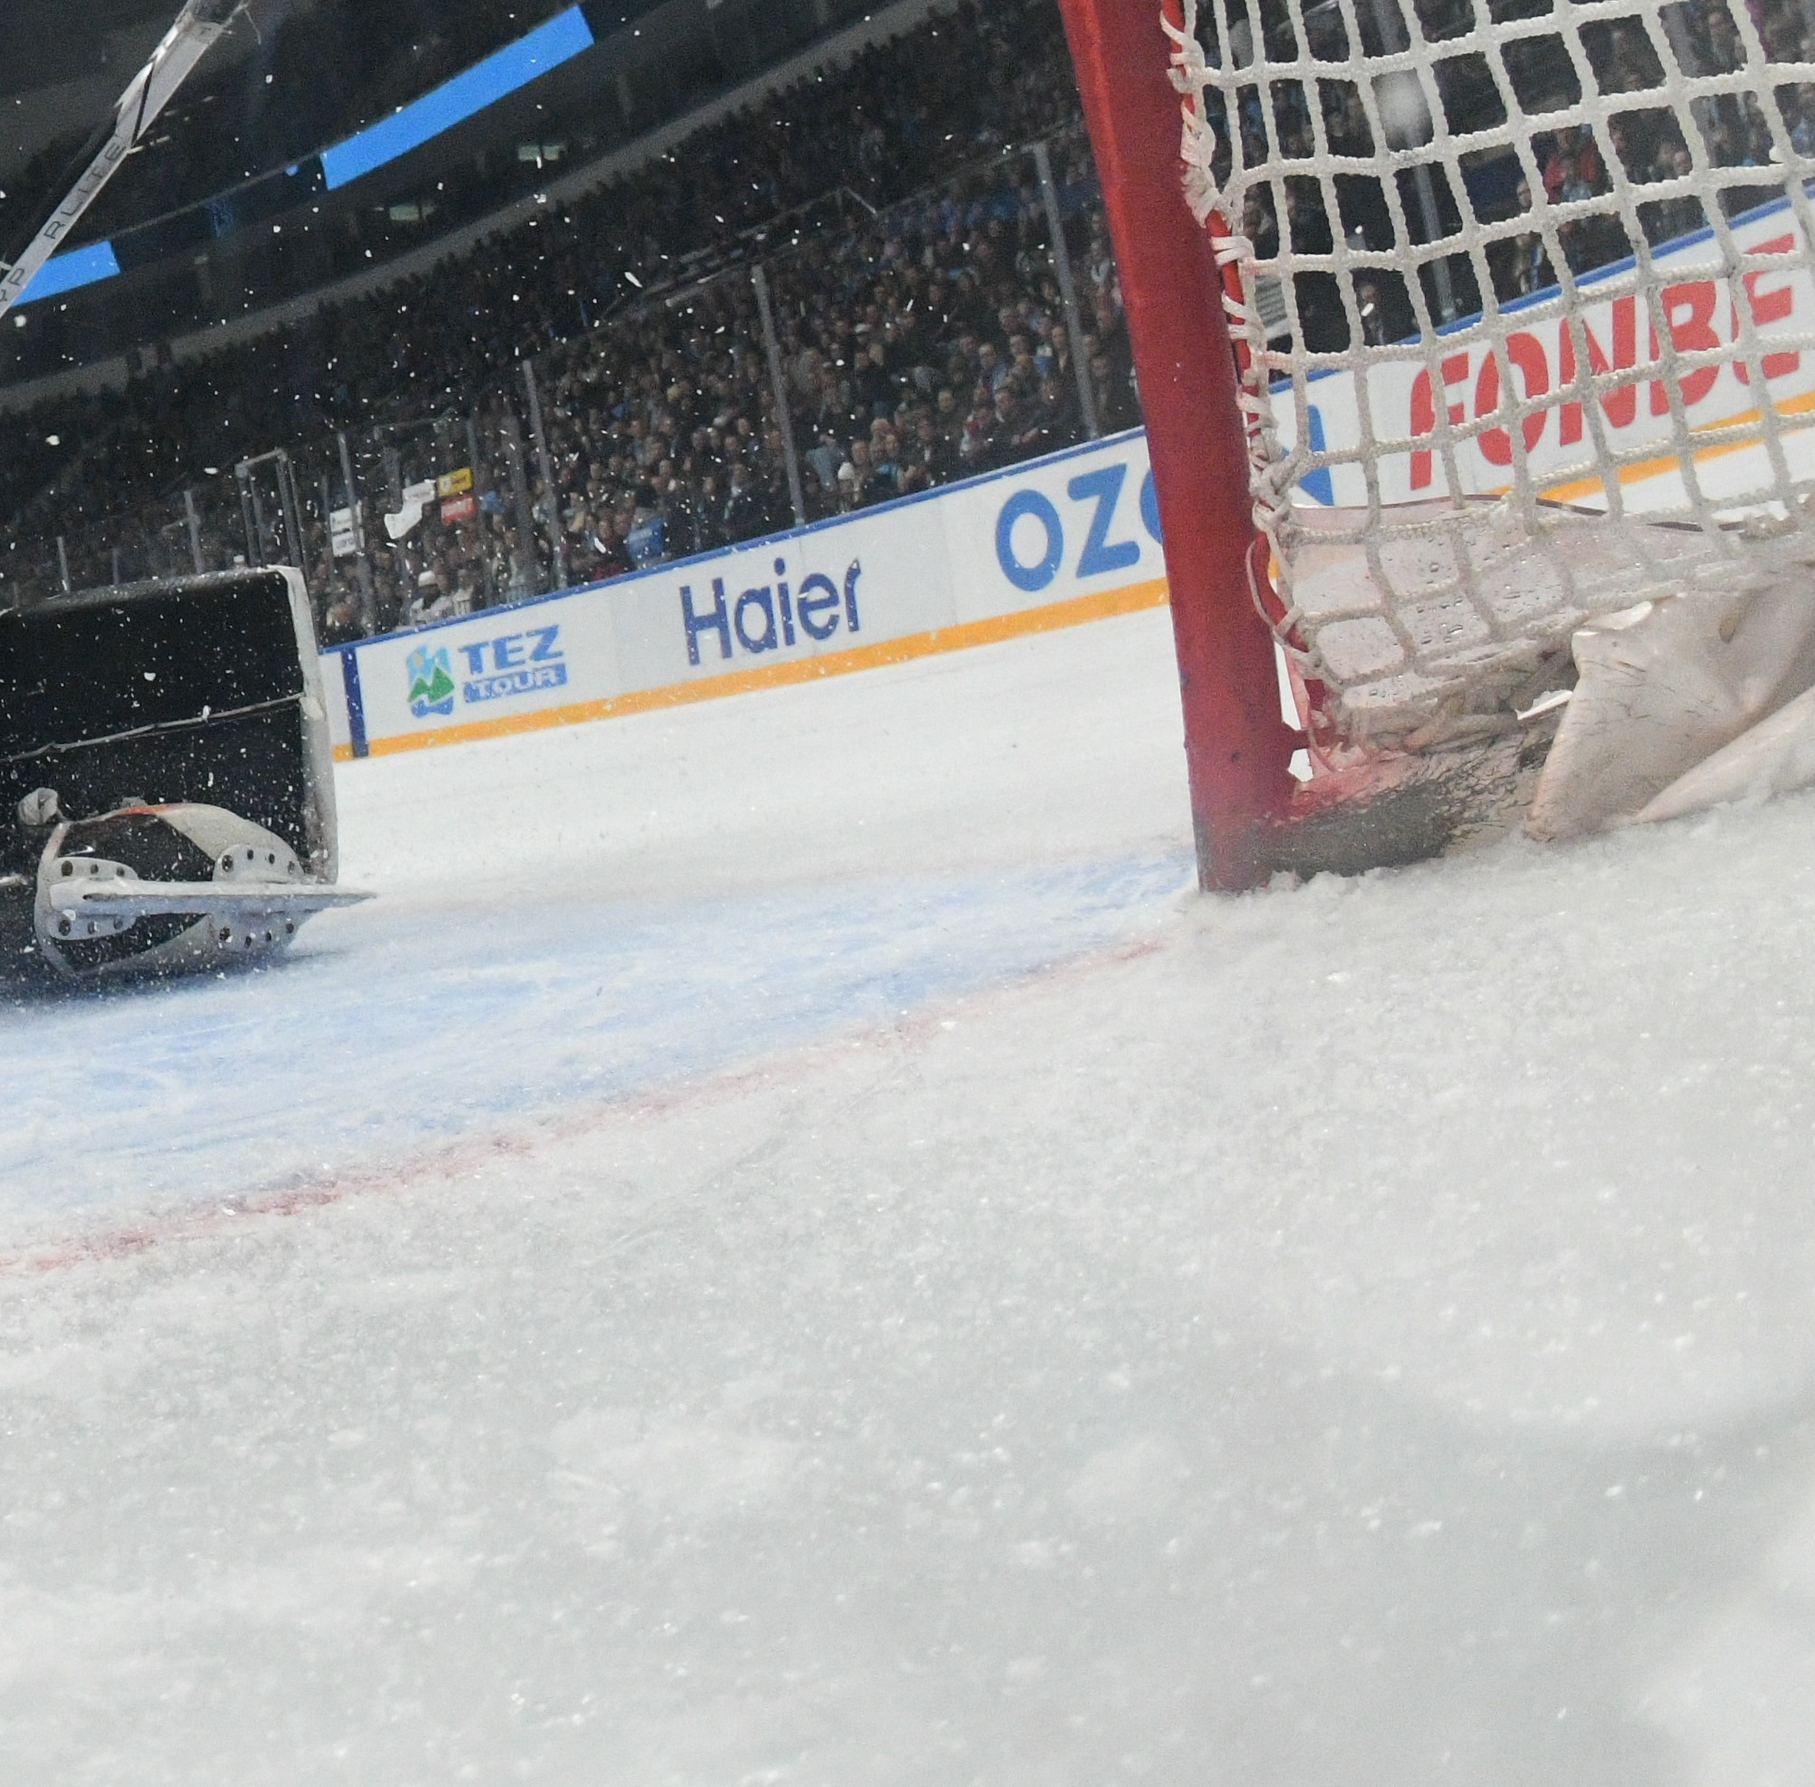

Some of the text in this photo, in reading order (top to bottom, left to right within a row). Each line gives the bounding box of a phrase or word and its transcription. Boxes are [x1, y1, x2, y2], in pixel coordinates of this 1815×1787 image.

[1410, 233, 1801, 491] FONBE
[459, 624, 564, 675] TEZ
[679, 558, 861, 665] Haier
[472, 670, 557, 701] TOUR
